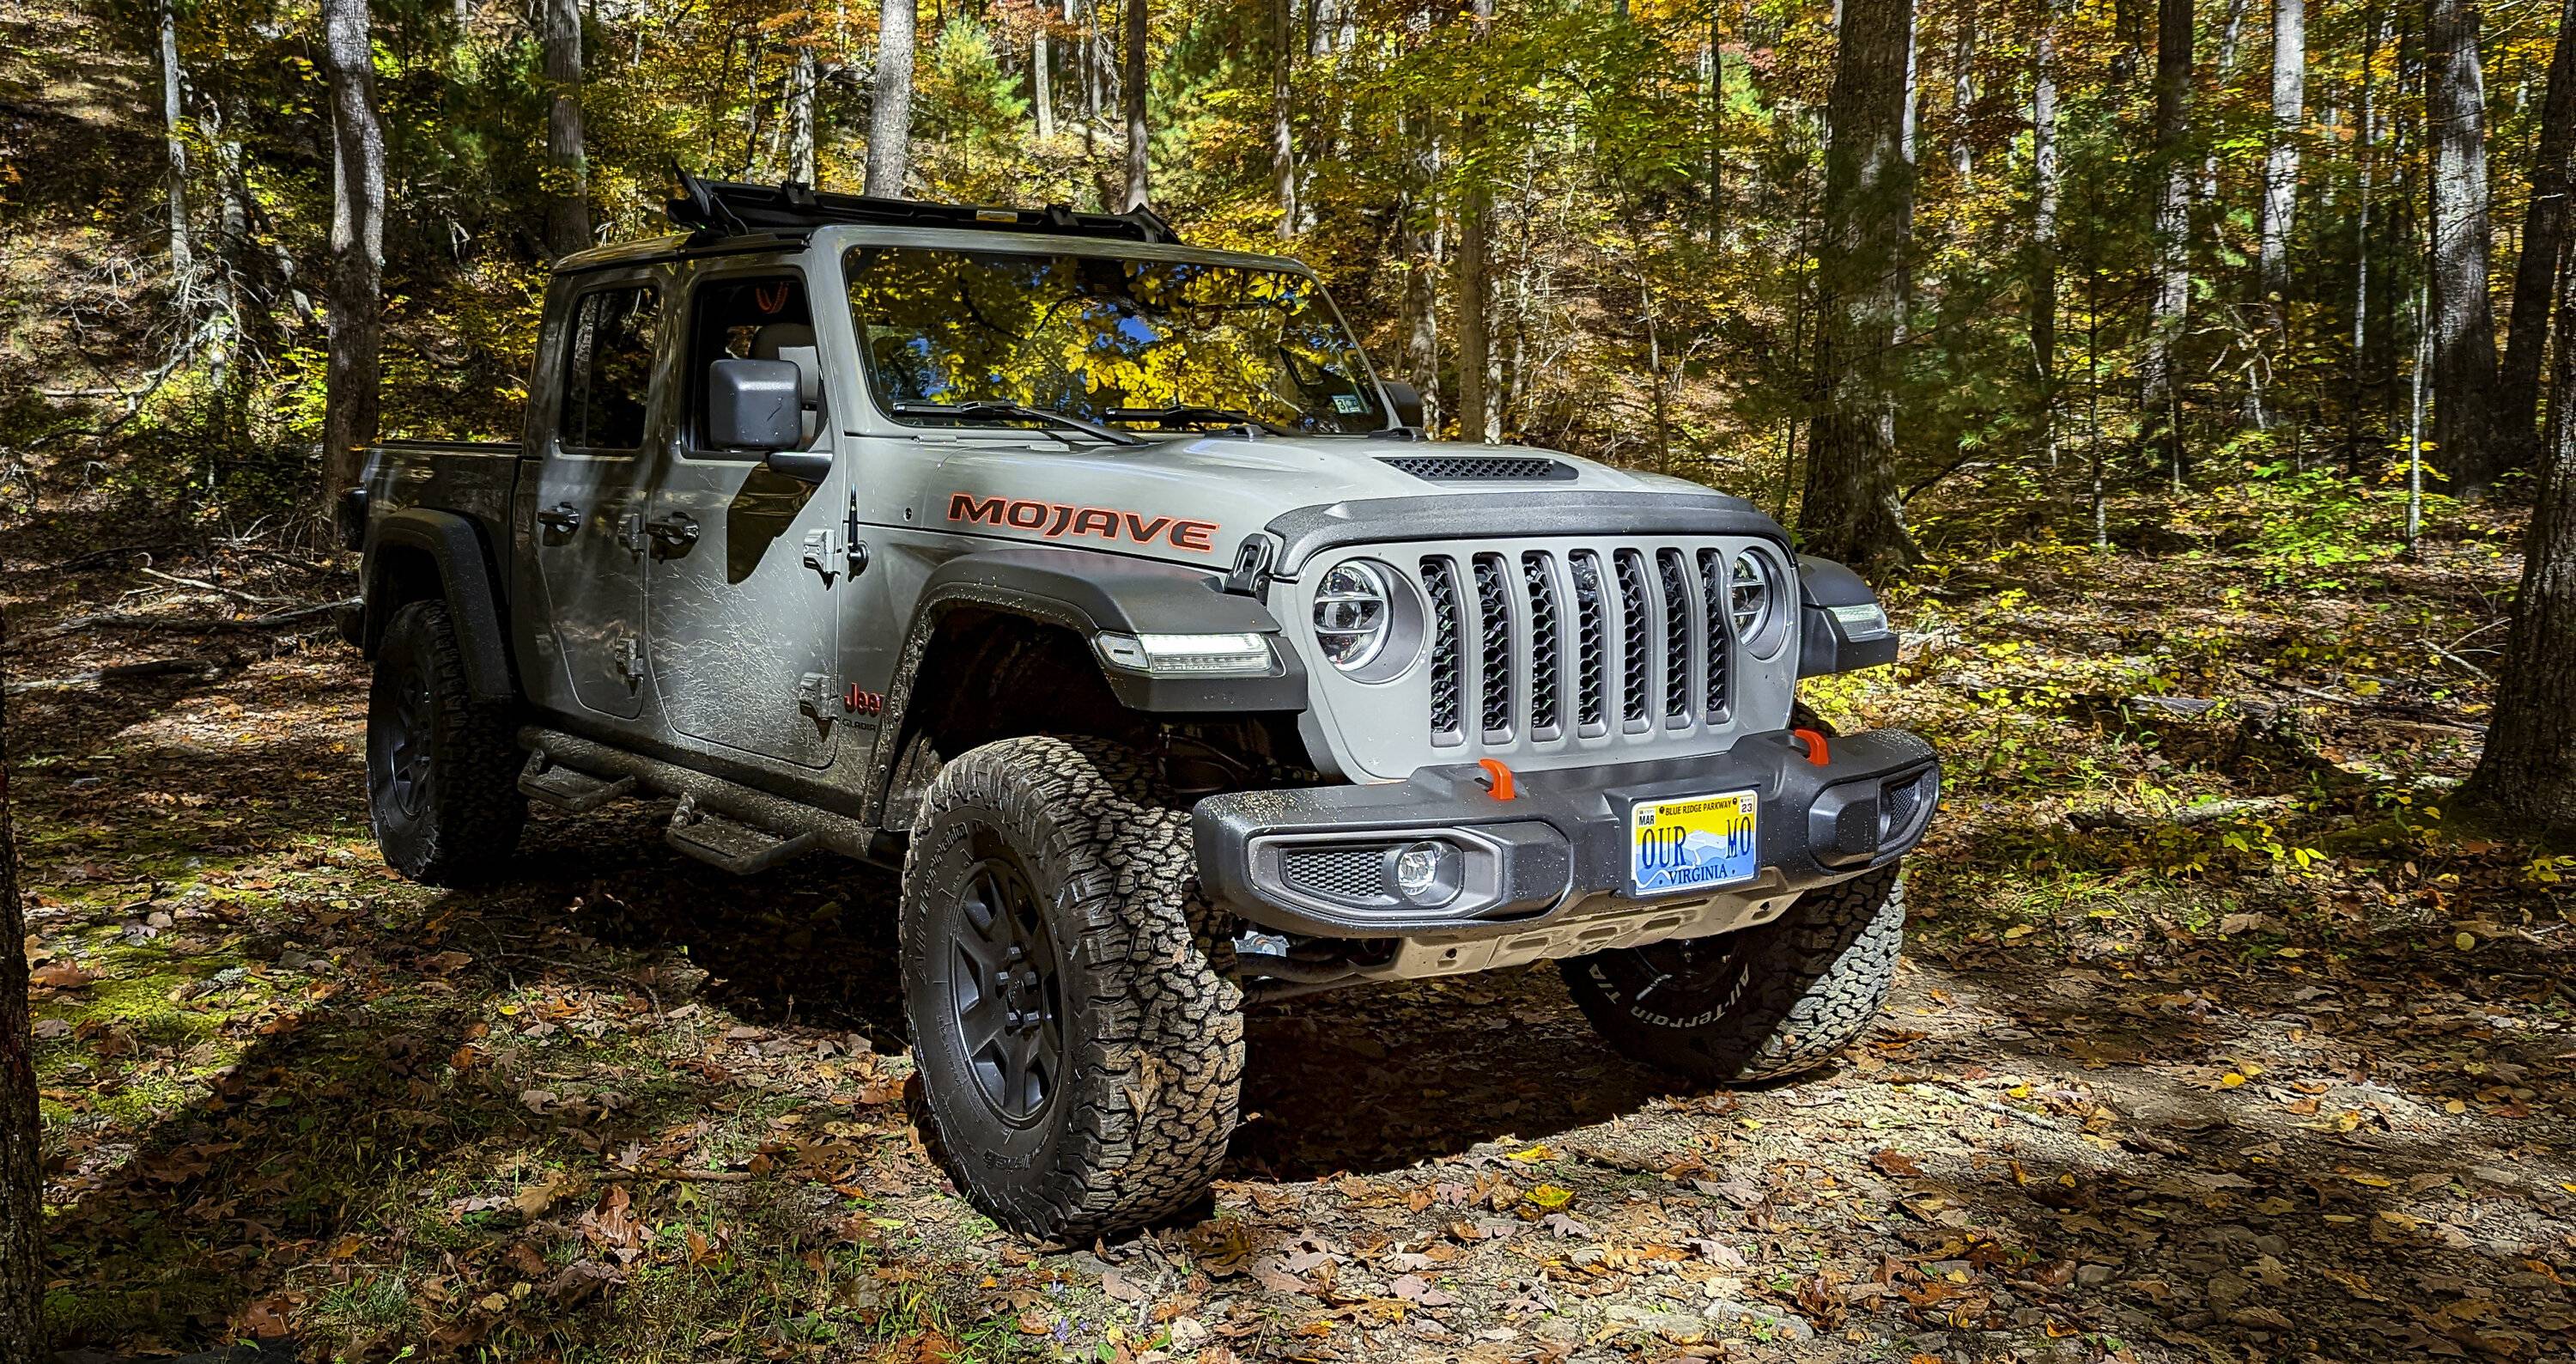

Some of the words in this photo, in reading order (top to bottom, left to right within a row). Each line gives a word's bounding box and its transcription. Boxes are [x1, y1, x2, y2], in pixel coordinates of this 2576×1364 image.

[947, 491, 1220, 553] MOJAVE
[842, 719, 876, 732] GLADIA
[1666, 807, 1681, 815] BLUE
[1683, 804, 1702, 814] RIDGE
[1704, 801, 1731, 811] PARKWAY
[1741, 804, 1753, 813] 23
[1639, 815, 1655, 825] MAR
[1642, 826, 1686, 869] OUR
[1726, 816, 1751, 859] MO
[1669, 864, 1728, 885] VIRGINIA
